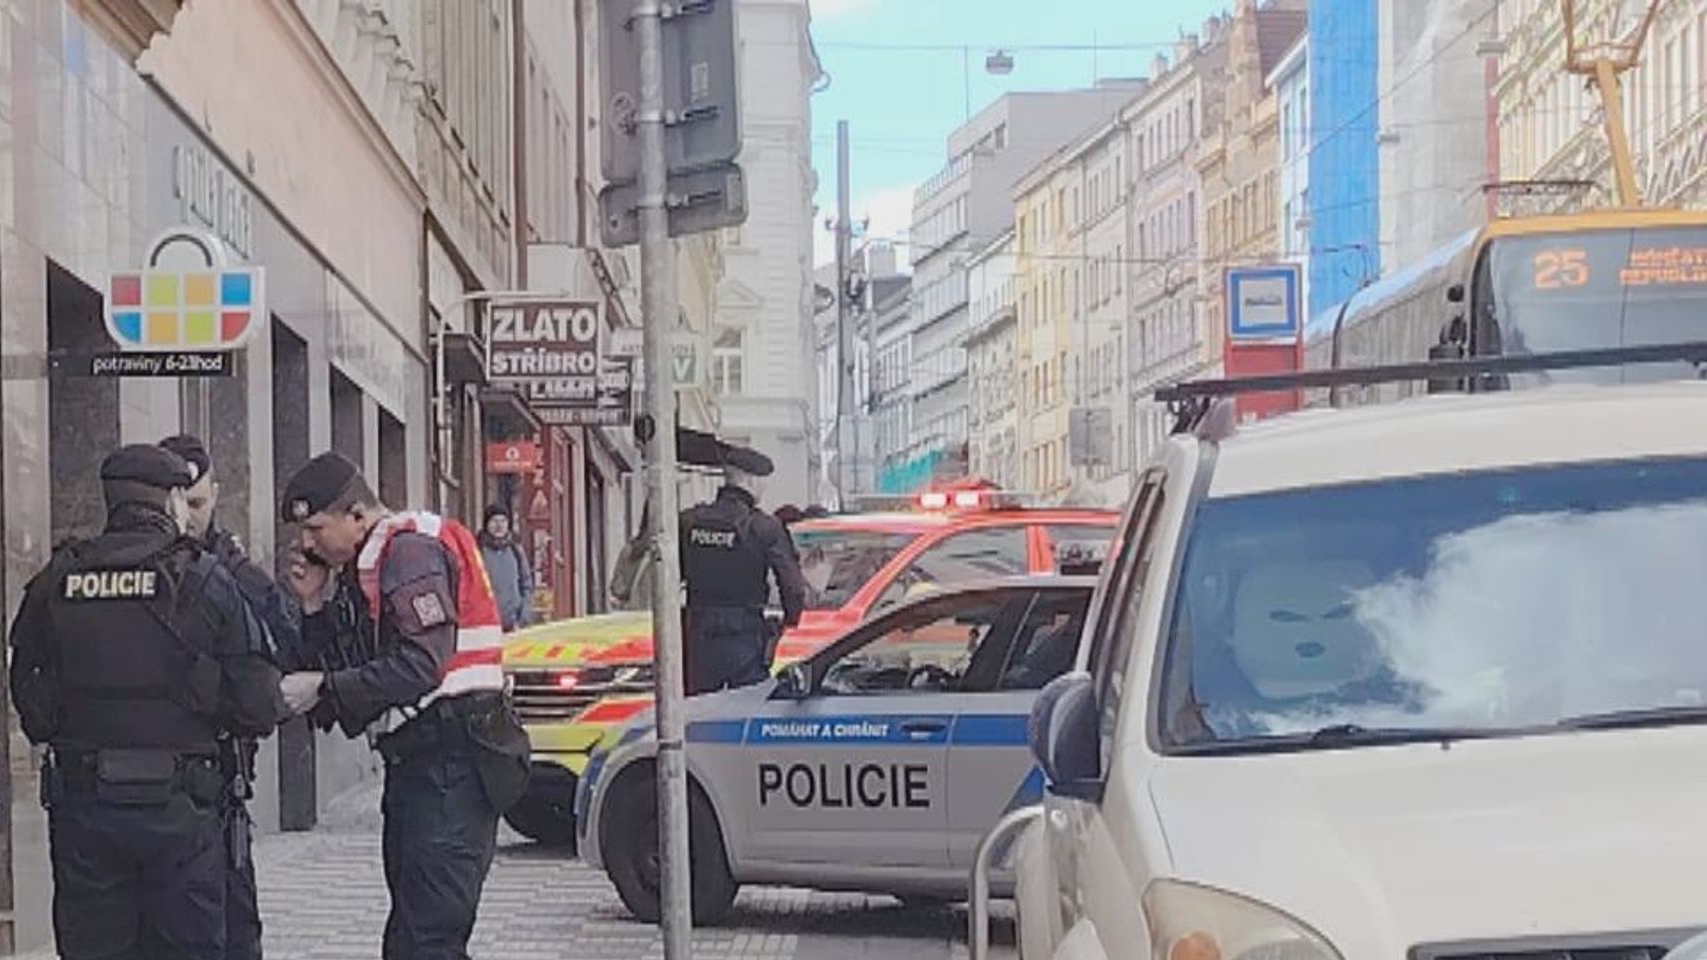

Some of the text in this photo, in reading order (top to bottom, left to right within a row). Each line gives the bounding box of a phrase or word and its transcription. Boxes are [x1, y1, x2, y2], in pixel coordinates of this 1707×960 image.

[1535, 251, 1588, 288] 25
[494, 308, 595, 342] ZLATO
[93, 355, 162, 374] potraviny
[491, 347, 595, 374] STŘÍBRO
[690, 528, 735, 548] POLICIE
[65, 570, 156, 598] POLICIE
[761, 720, 890, 737] POMÁHAT A CHRÁNIT
[759, 763, 930, 808] POLICIE
